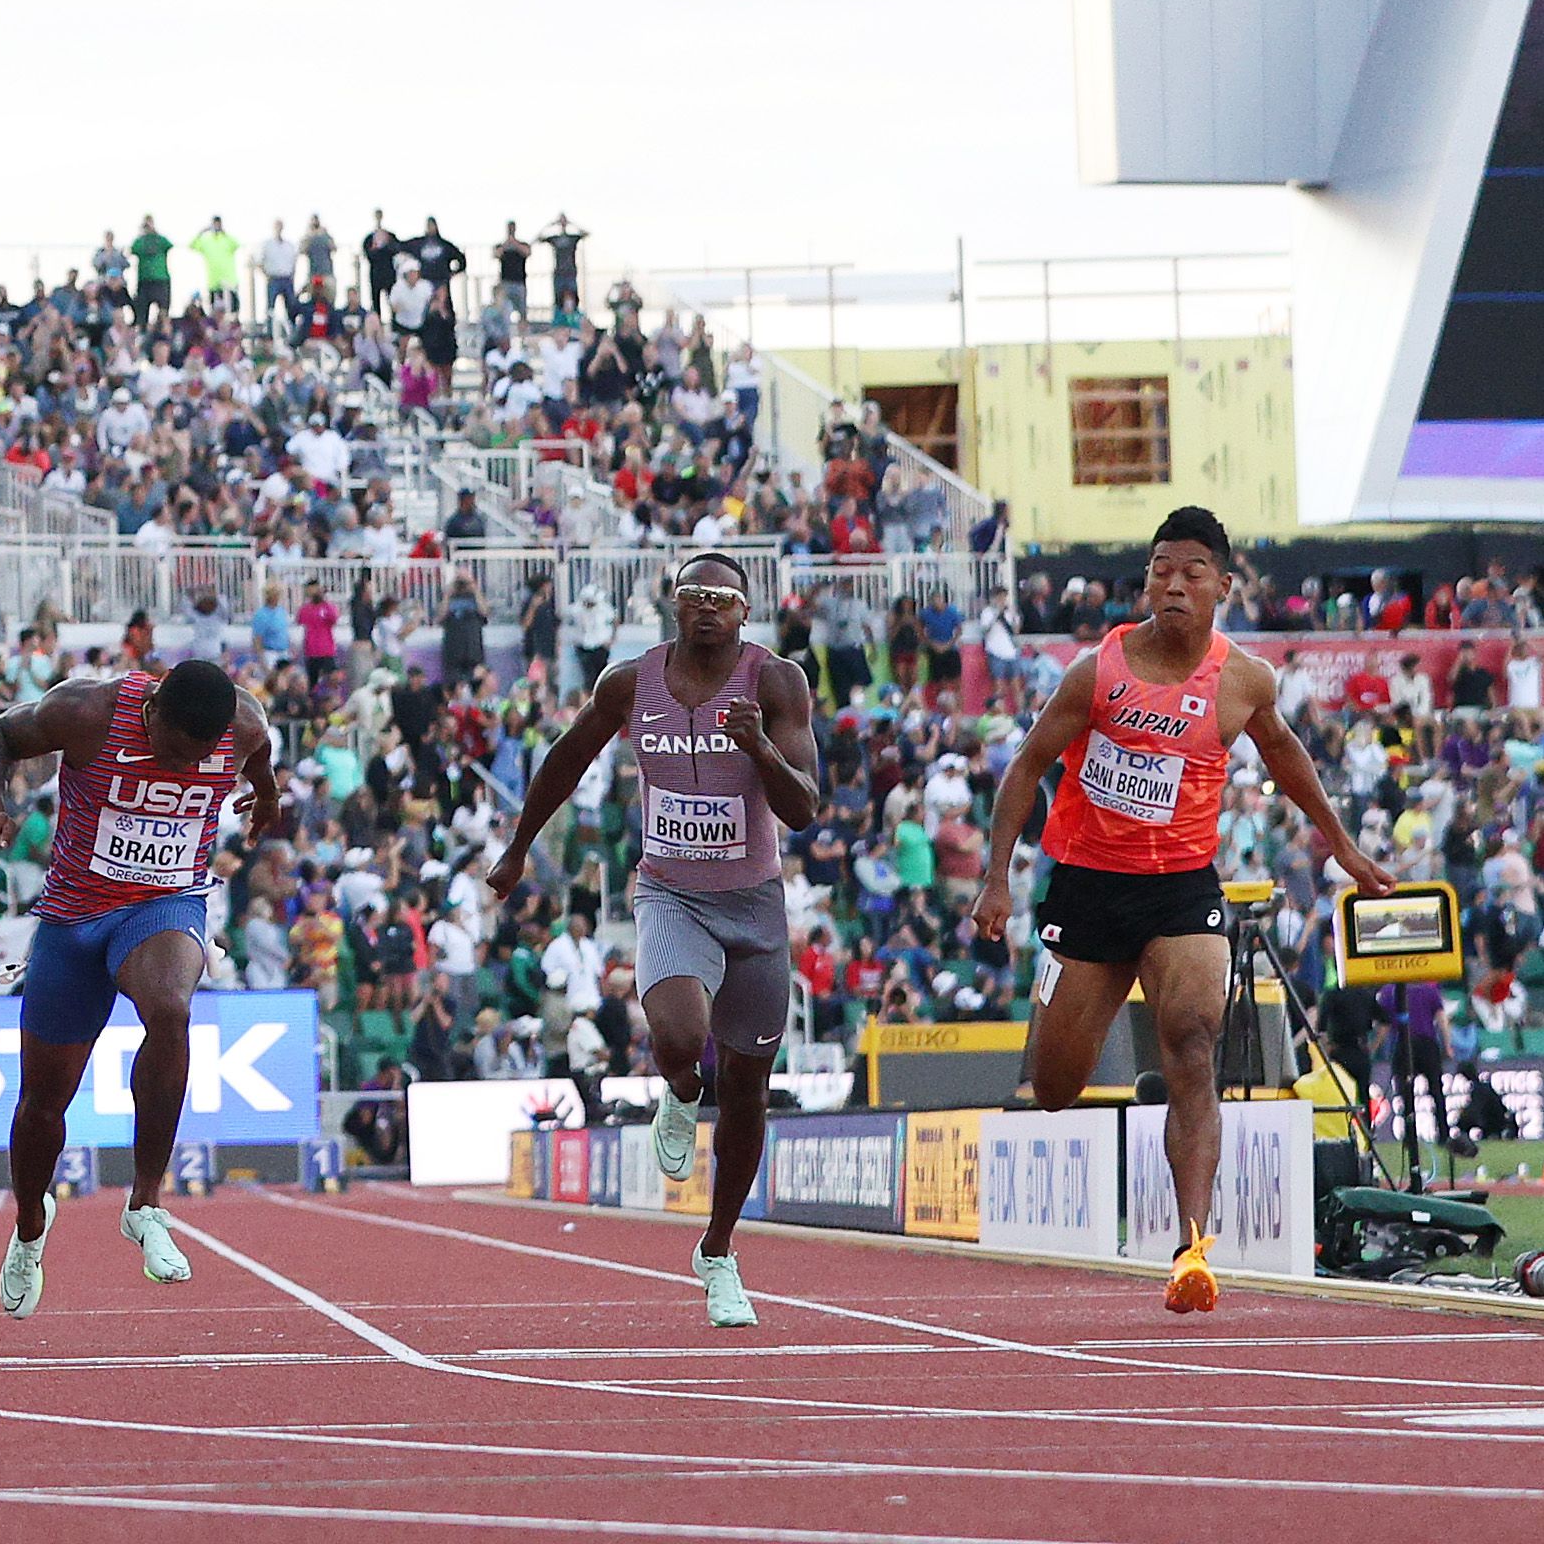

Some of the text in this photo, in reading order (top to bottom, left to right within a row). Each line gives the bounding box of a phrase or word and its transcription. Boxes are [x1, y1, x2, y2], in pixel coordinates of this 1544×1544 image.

[1111, 707, 1189, 738] JAPAN
[641, 733, 740, 754] CANADA
[1113, 746, 1168, 774] TDK
[1084, 758, 1174, 803] SANI BROWN
[108, 776, 214, 816] USA
[674, 799, 731, 817] TDK
[1087, 791, 1155, 819] OREGON22
[134, 818, 191, 838] TDK
[656, 815, 736, 842] BROWN
[108, 835, 187, 865] BRACY
[106, 866, 177, 885] OREGON22
[179, 1151, 204, 1181] 2
